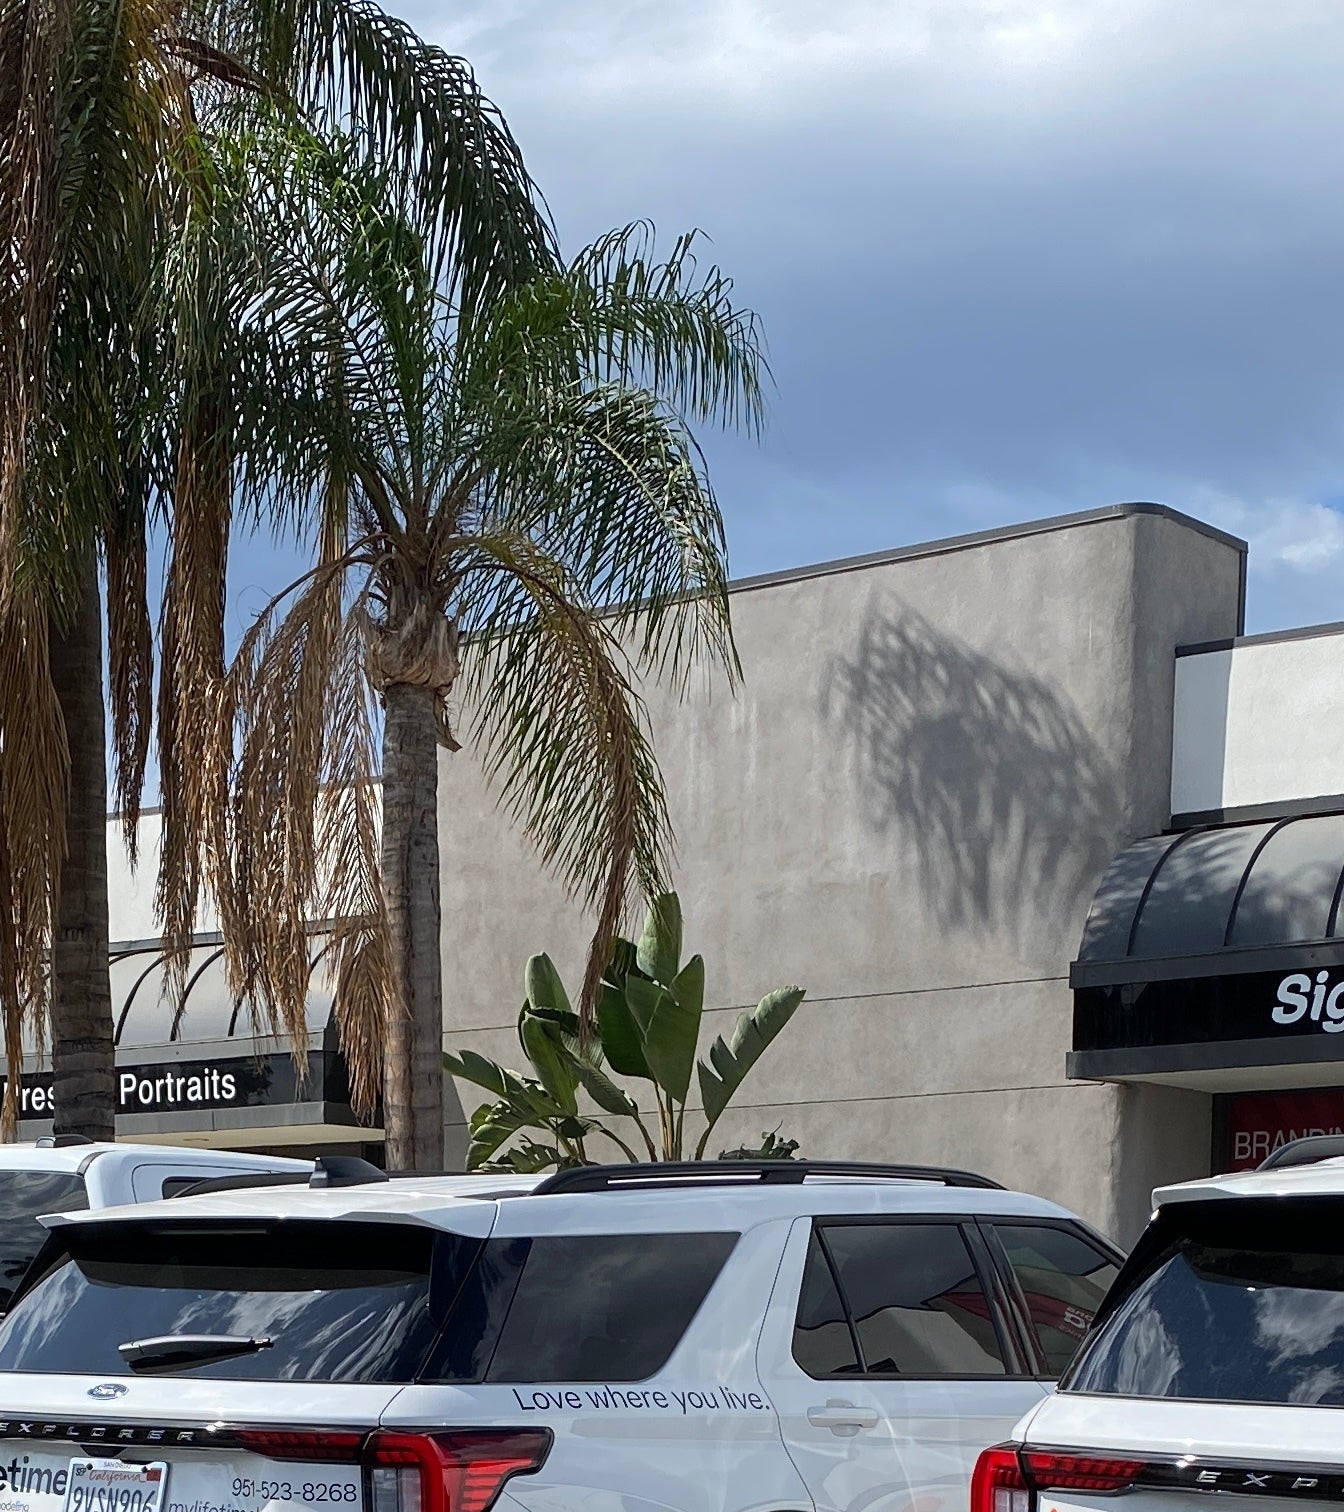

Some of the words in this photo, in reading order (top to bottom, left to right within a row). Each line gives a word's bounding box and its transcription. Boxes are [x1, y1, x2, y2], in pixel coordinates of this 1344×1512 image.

[119, 1068, 236, 1105] Portraits
[512, 1388, 583, 1411] Love
[585, 1385, 669, 1409] where
[671, 1390, 720, 1415] you
[718, 1385, 771, 1410] live.
[231, 1477, 357, 1502] 951-523-8268
